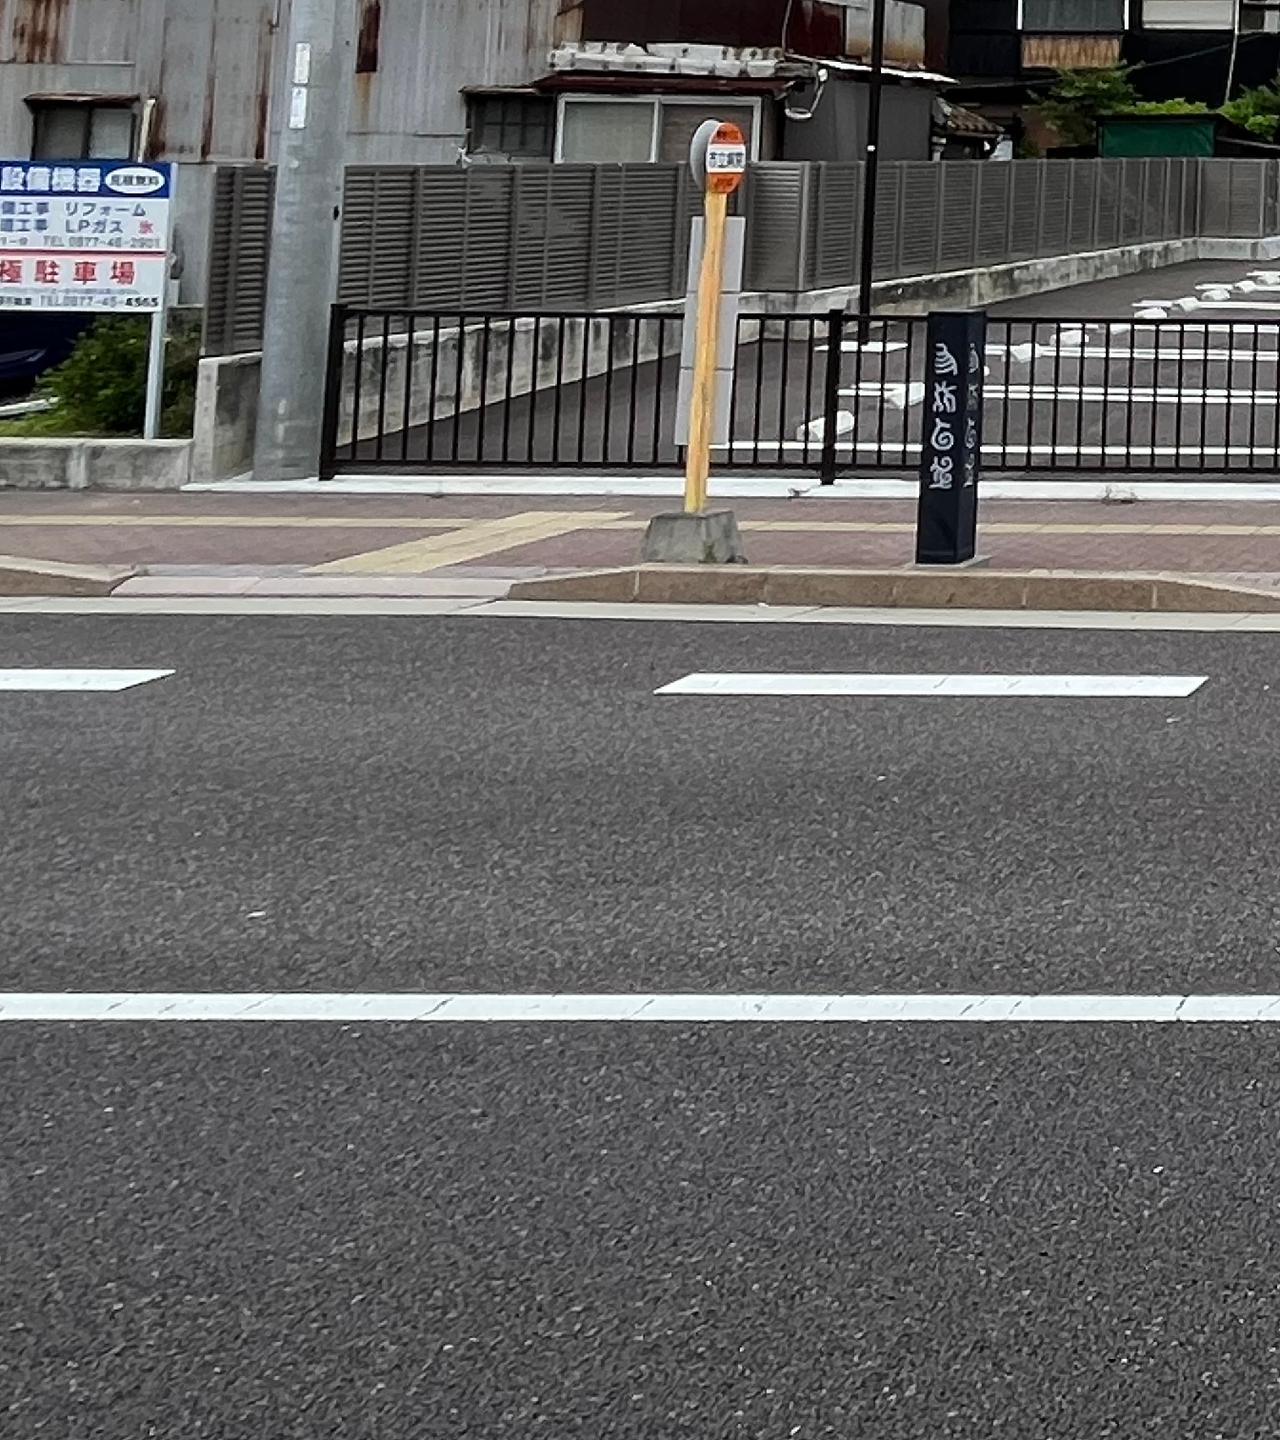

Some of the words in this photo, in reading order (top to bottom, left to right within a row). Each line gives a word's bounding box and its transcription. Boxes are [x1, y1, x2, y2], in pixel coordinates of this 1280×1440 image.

[66, 202, 146, 216] リフォーム
[66, 219, 123, 233] LPガス
